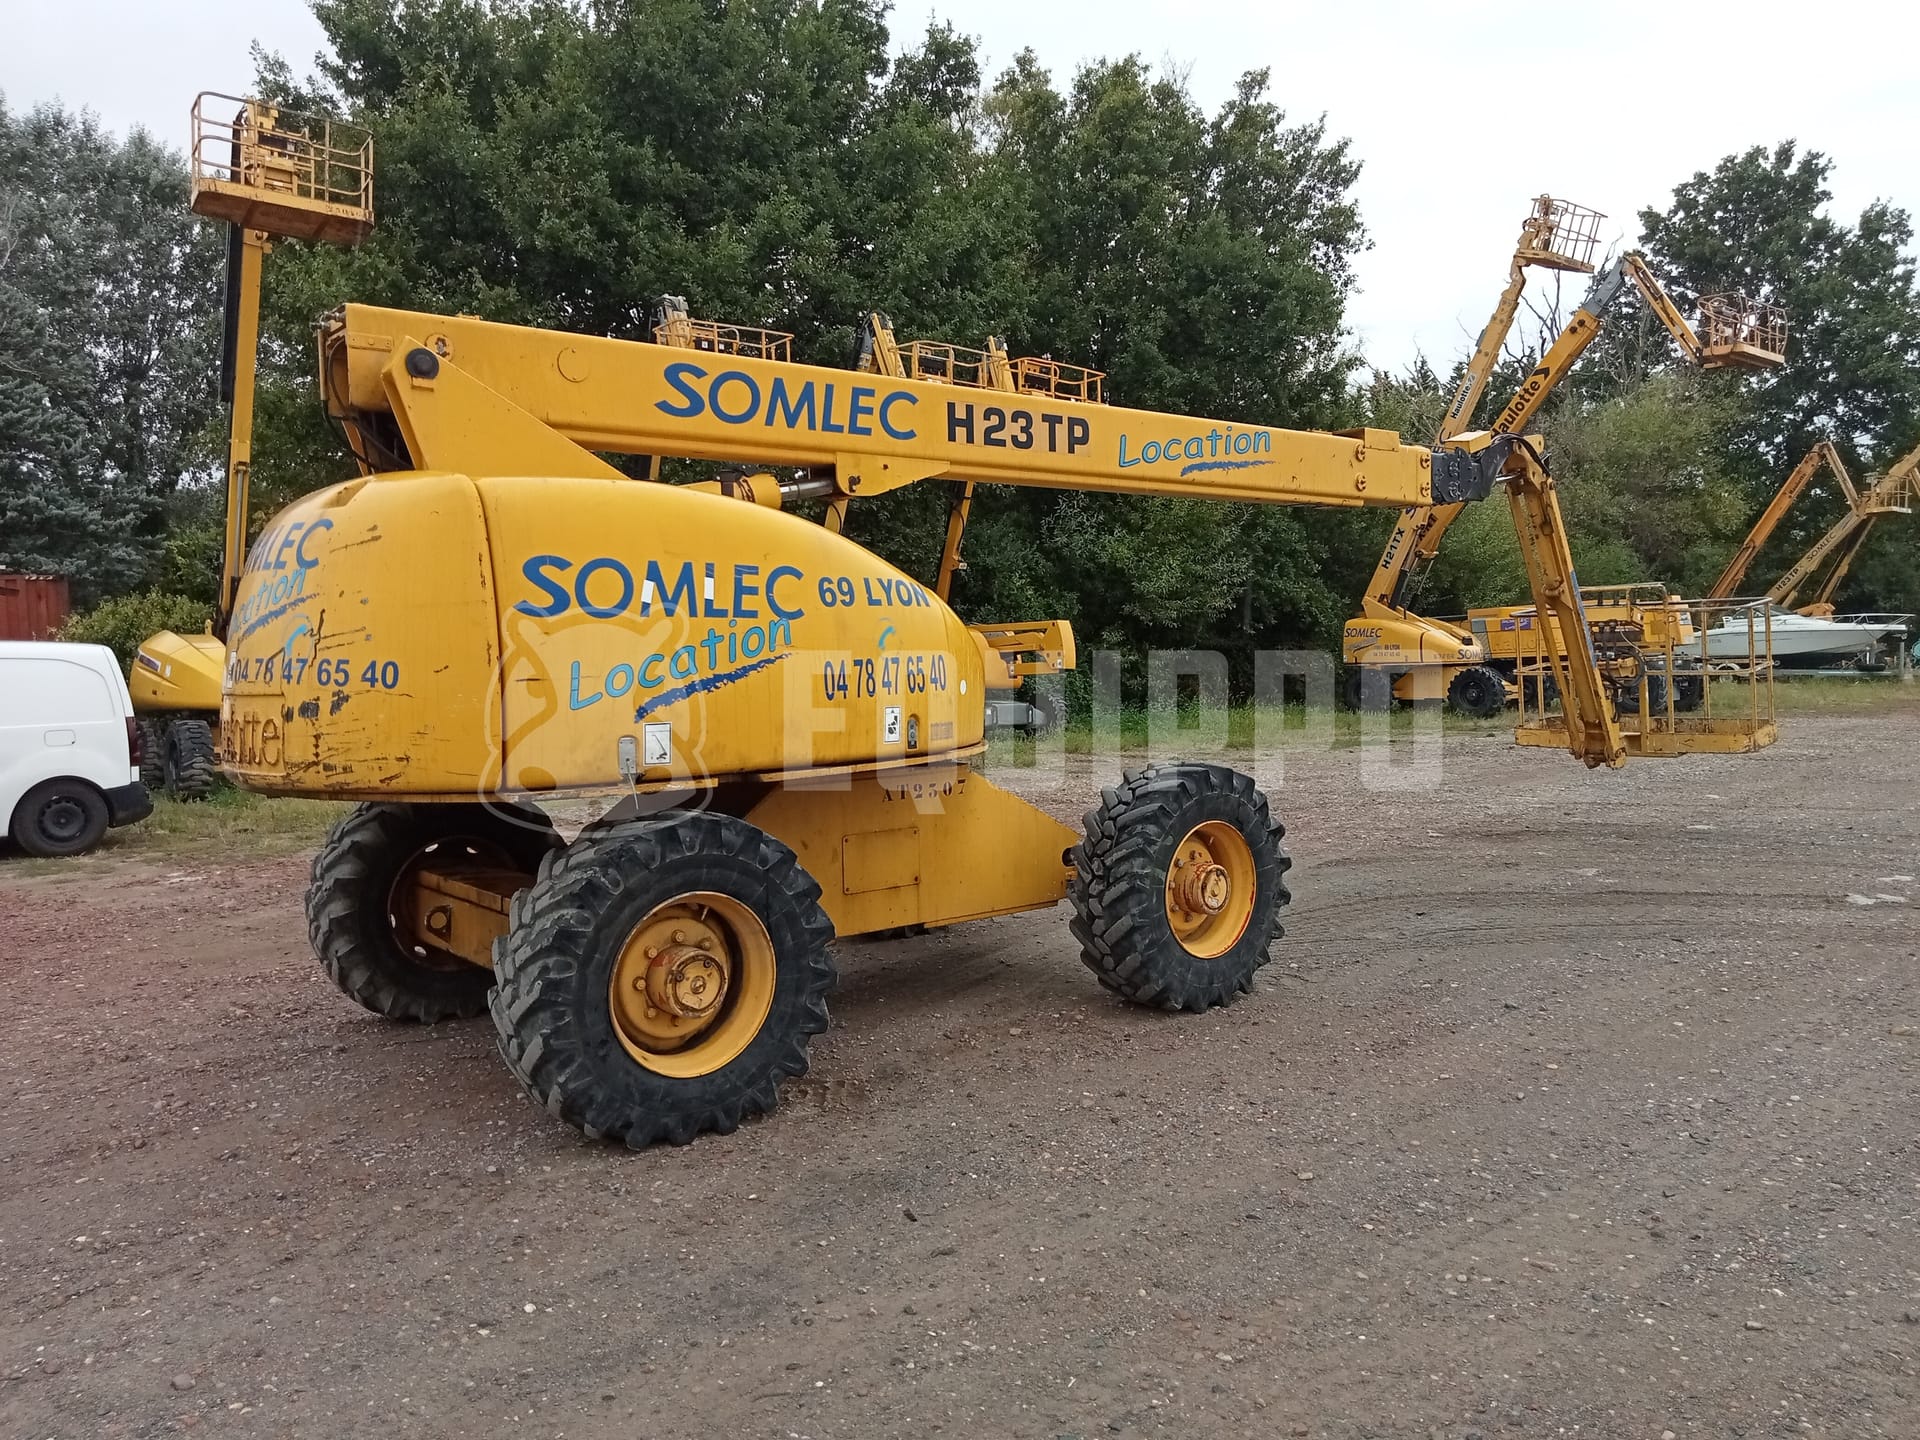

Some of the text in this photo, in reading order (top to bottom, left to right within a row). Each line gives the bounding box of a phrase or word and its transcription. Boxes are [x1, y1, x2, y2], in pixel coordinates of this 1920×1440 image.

[654, 362, 1270, 467] SOMLEC H23TP Location
[1450, 384, 1471, 419] Haulotte
[1381, 527, 1405, 569] H21TX
[512, 555, 931, 620] SOMLEC 69 LYON
[1344, 627, 1383, 638] SOMLEC
[255, 658, 274, 683] 78
[283, 658, 308, 684] 47
[316, 659, 350, 687] 65
[361, 660, 400, 689] 40
[569, 617, 792, 710] Location
[823, 655, 946, 701] 04 78 47 65 40
